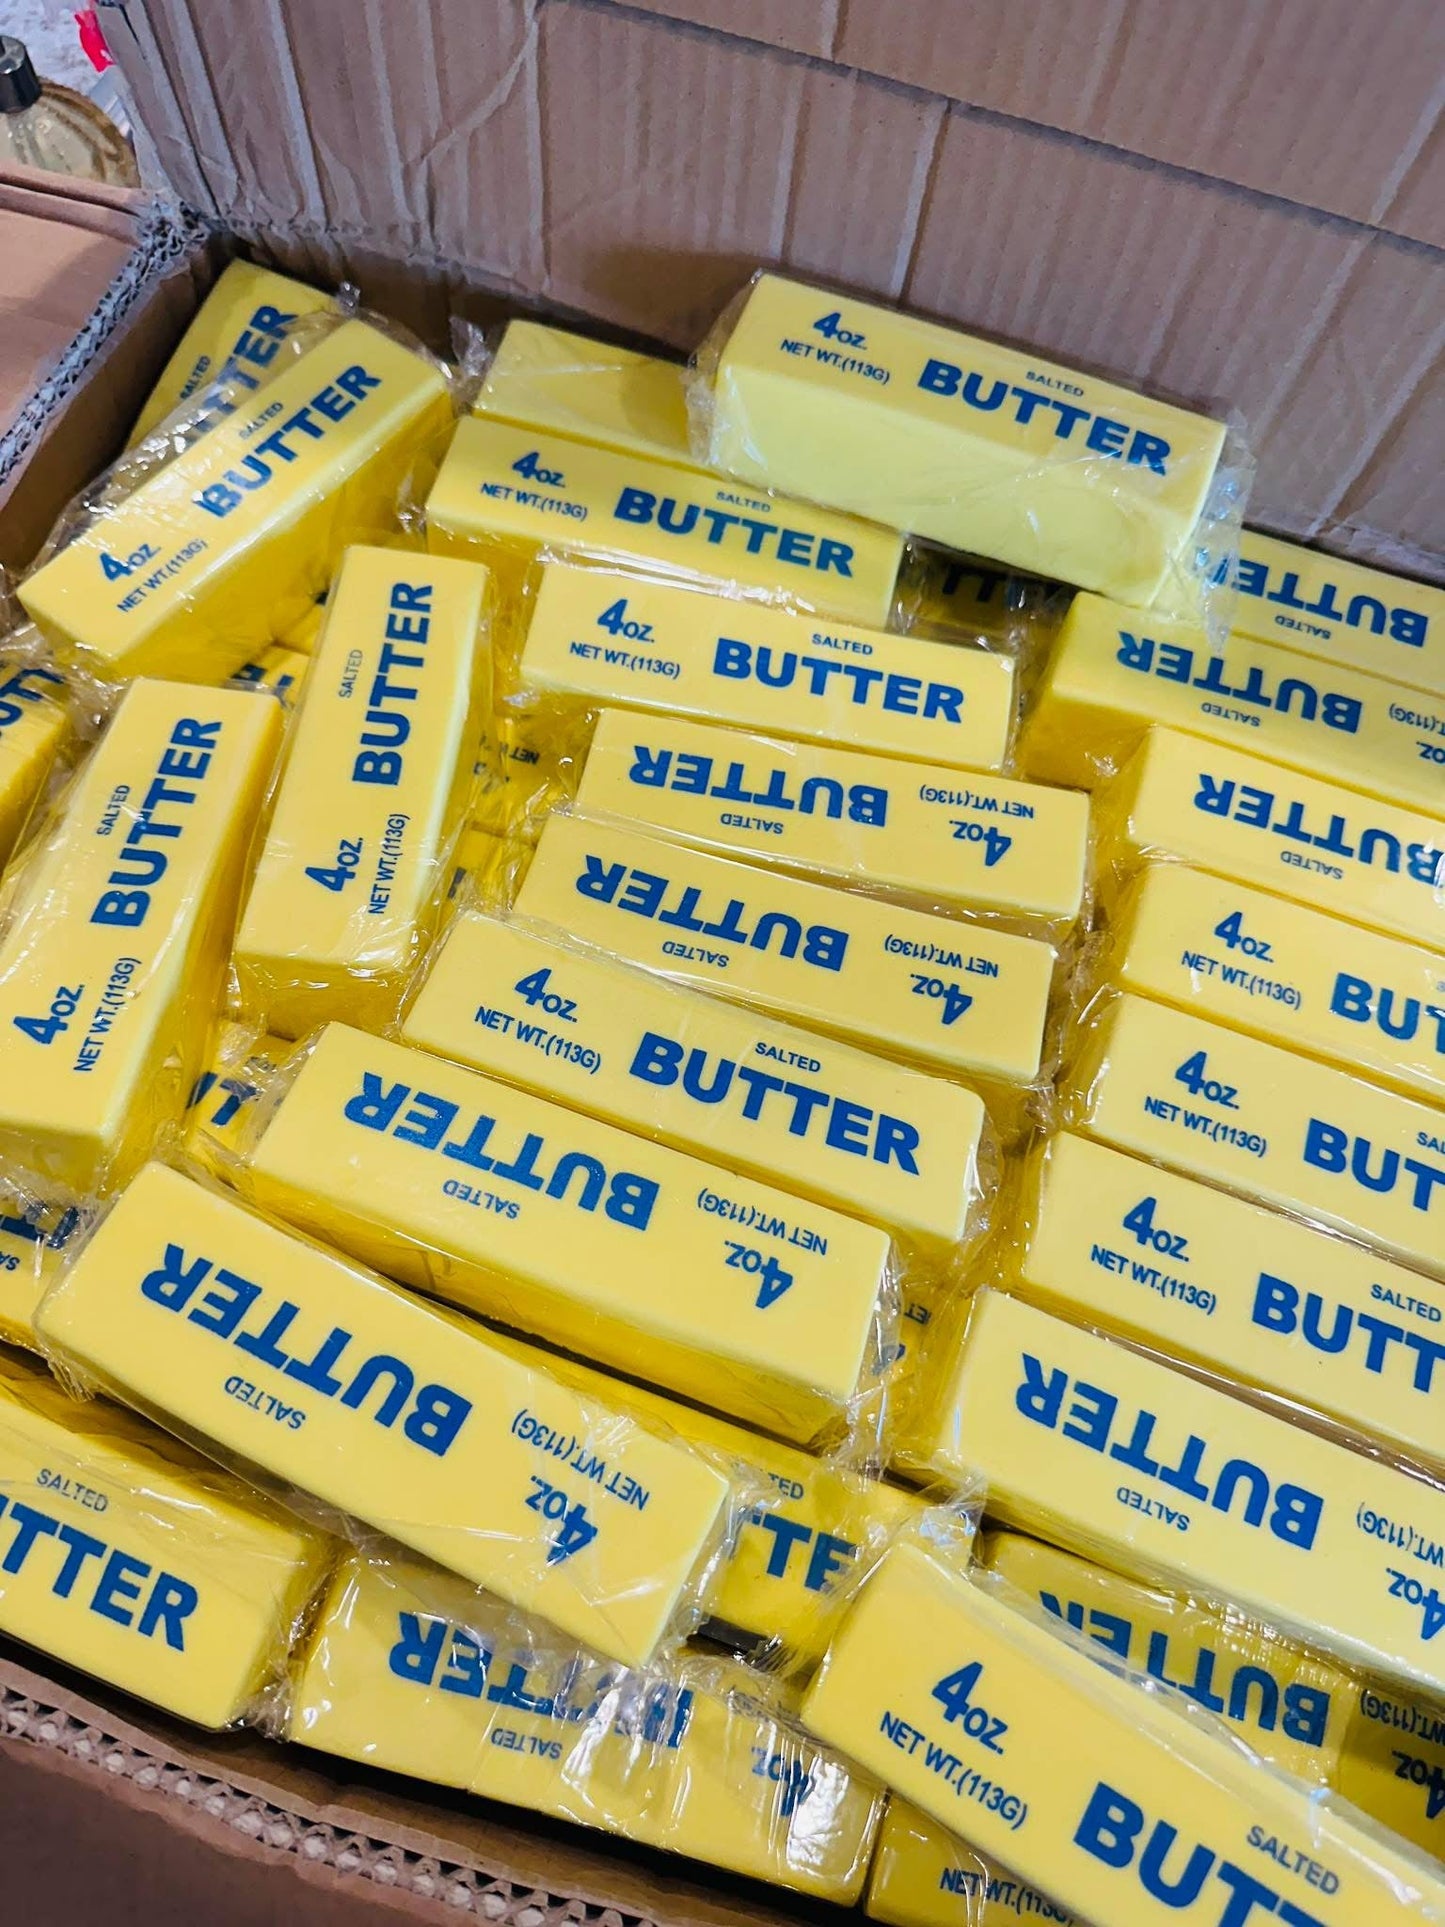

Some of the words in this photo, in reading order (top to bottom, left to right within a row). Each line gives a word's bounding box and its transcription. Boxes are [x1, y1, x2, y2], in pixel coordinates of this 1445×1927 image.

[780, 338, 815, 358] NET
[1026, 370, 1084, 397] SALTED
[916, 358, 1172, 477] BUTTER
[191, 364, 383, 518] BUTTER
[480, 482, 514, 499] NET
[716, 491, 771, 513] SALTED
[612, 485, 855, 579] BUTTER
[116, 587, 147, 613] NET
[812, 633, 874, 656] SALTED
[1275, 615, 1332, 640] SALTED
[569, 641, 603, 660] NET
[338, 648, 364, 700] SALTED
[351, 582, 433, 787] BUTTER
[712, 637, 965, 724] BUTTER
[1115, 630, 1364, 735] BUTTER
[1200, 702, 1261, 728] SALTED
[628, 744, 889, 828] BUTTER
[90, 717, 223, 928] BUTTER
[95, 784, 131, 836] SALTED
[720, 813, 784, 835] SALTED
[1000, 800, 1035, 820] NET
[1193, 773, 1444, 888] BUTTER
[1280, 850, 1343, 880] SALTED
[367, 881, 392, 916] NET
[575, 854, 850, 973] BUTTER
[661, 940, 730, 968] SALTED
[964, 956, 999, 979] NET
[1181, 950, 1221, 976] NET
[474, 1005, 516, 1034] NET
[72, 1033, 104, 1073] NET
[754, 1041, 822, 1073] SALTED
[628, 1031, 920, 1175] BUTTER
[1143, 1096, 1184, 1123] NET
[343, 1071, 661, 1232] BUTTER
[442, 1179, 521, 1220] SALTED
[787, 1226, 828, 1256] NET
[1090, 1243, 1130, 1275] NET
[1370, 1283, 1442, 1323] SALTED
[140, 1242, 474, 1455] BUTTER
[1252, 1272, 1445, 1394] BUTT
[224, 1375, 307, 1430] SALTED
[1014, 1353, 1325, 1549] BUTTER
[36, 1468, 108, 1512] SALTED
[604, 1471, 650, 1511] NET
[1116, 1486, 1191, 1532] SALTED
[0, 1494, 199, 1652] TTER
[491, 1727, 564, 1760] SALTED
[879, 1711, 926, 1756] NET
[1247, 1825, 1339, 1895] SALTED
